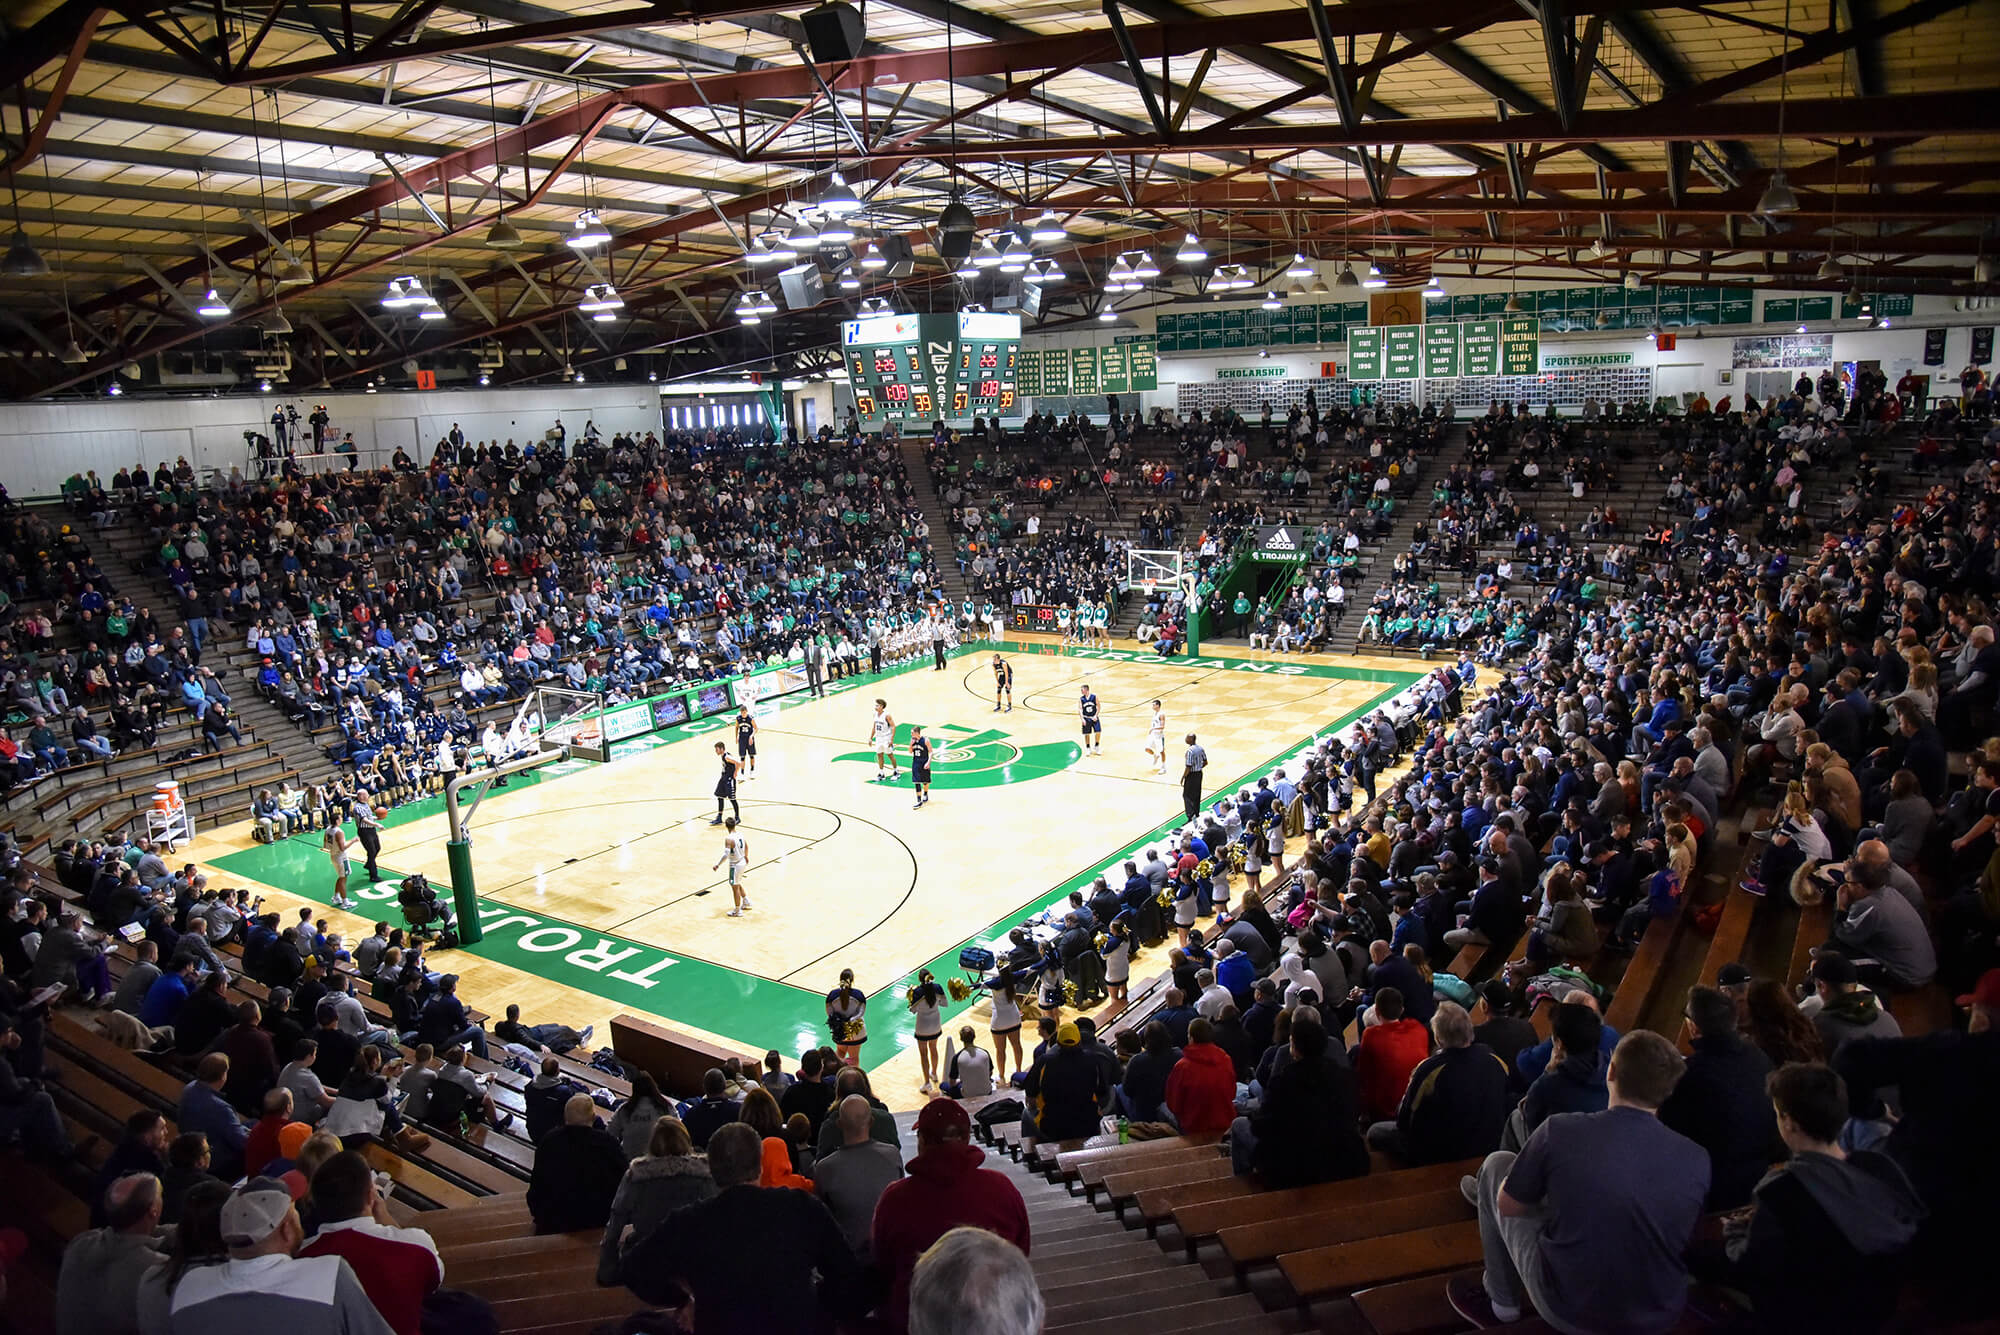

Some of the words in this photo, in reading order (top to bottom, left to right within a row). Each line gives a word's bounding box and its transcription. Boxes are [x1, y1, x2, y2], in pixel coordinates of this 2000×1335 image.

[1504, 333, 1537, 342] BASKETBALL
[911, 357, 919, 370] 3
[964, 355, 969, 367] 3
[1009, 355, 1015, 367] 3
[1508, 354, 1532, 362] CHAMPS
[1544, 354, 1631, 366] SPORTSMANSHIP
[856, 361, 863, 374] 3
[1217, 368, 1285, 378] SCHOLARSHIP
[423, 372, 428, 387] J
[915, 395, 932, 412] 39
[954, 393, 968, 409] 57
[1000, 392, 1014, 407] 39
[858, 398, 875, 414] 57
[1266, 542, 1295, 550] adidas
[1017, 614, 1028, 625] 57
[1075, 649, 1311, 674] TROJANS
